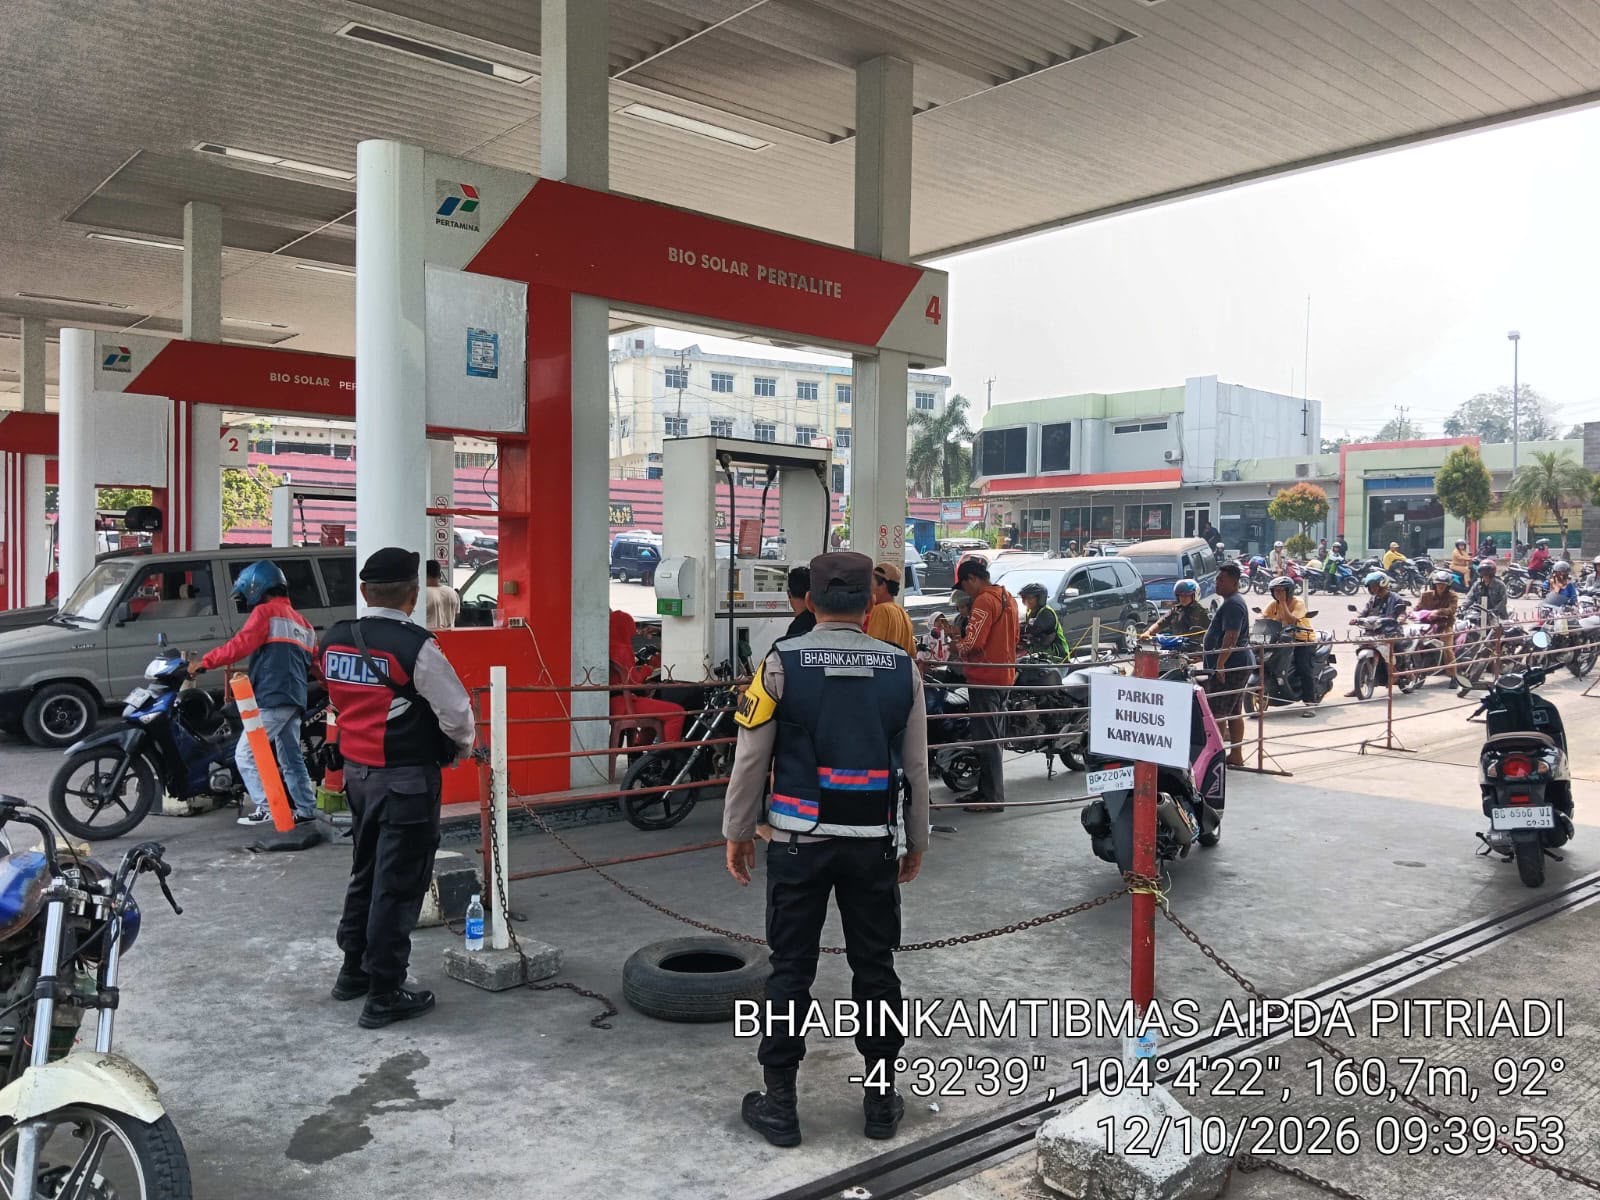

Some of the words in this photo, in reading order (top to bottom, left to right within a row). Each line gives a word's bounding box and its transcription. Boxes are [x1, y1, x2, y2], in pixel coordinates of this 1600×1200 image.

[435, 218, 480, 232] PERTAMINA
[667, 247, 697, 266] BIO
[701, 255, 749, 277] SOLAR
[757, 264, 842, 299] PERTALITE
[925, 295, 942, 325] 4
[269, 372, 291, 382] BIO
[294, 375, 330, 387] SOLAR
[229, 437, 239, 452] 2
[804, 652, 893, 667] BHABINKAMTIBMAS
[1117, 689, 1164, 706] PARKIR
[1115, 708, 1165, 727] KHUSUS
[1107, 727, 1172, 749] KARYAWAN
